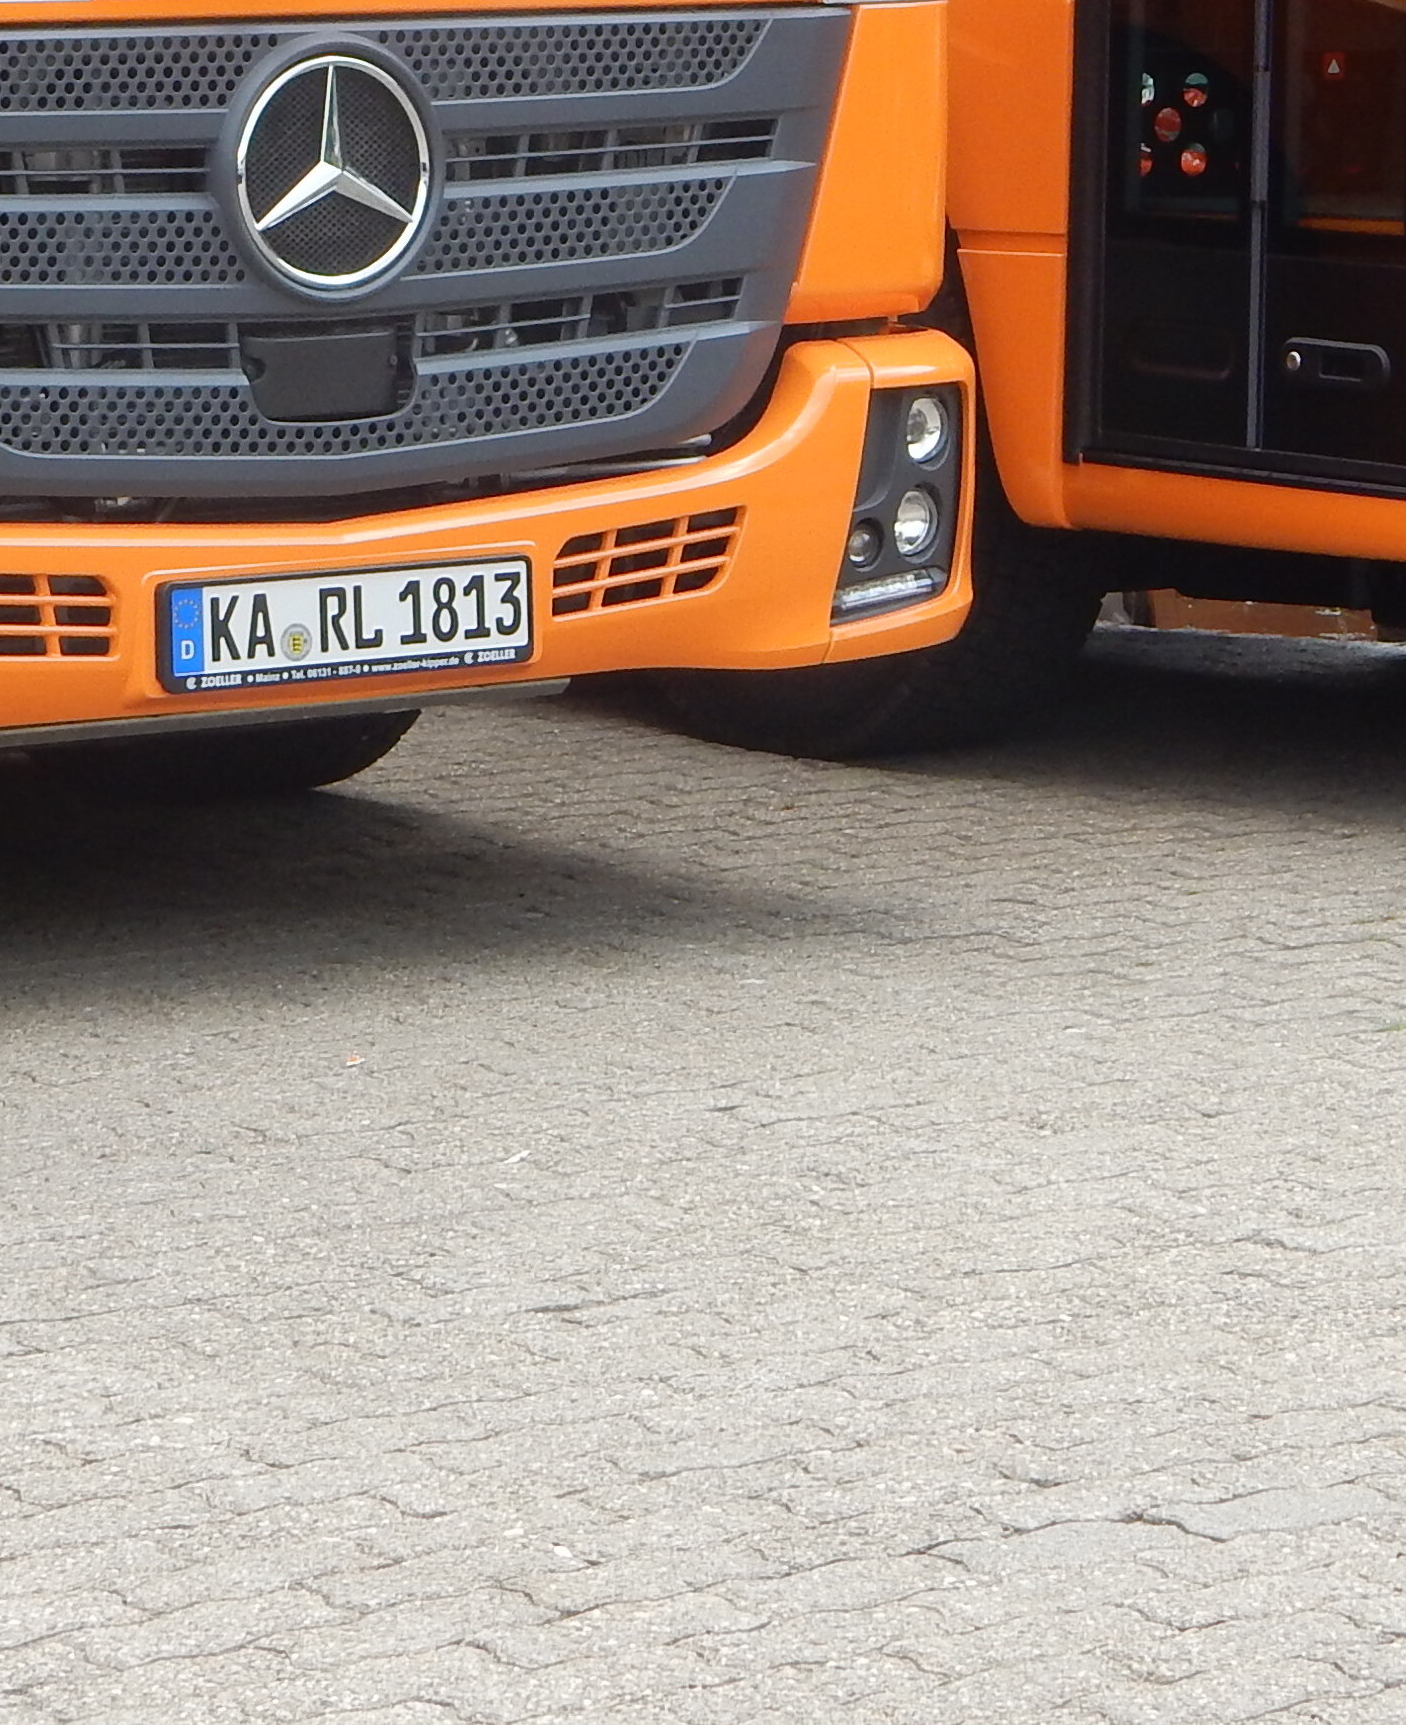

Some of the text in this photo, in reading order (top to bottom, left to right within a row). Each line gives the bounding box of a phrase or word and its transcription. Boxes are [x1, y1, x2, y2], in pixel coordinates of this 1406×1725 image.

[210, 570, 522, 663] KA RL 1813
[180, 640, 195, 661] D
[200, 673, 243, 689] ZOELLER
[477, 648, 516, 663] ZOELLER
